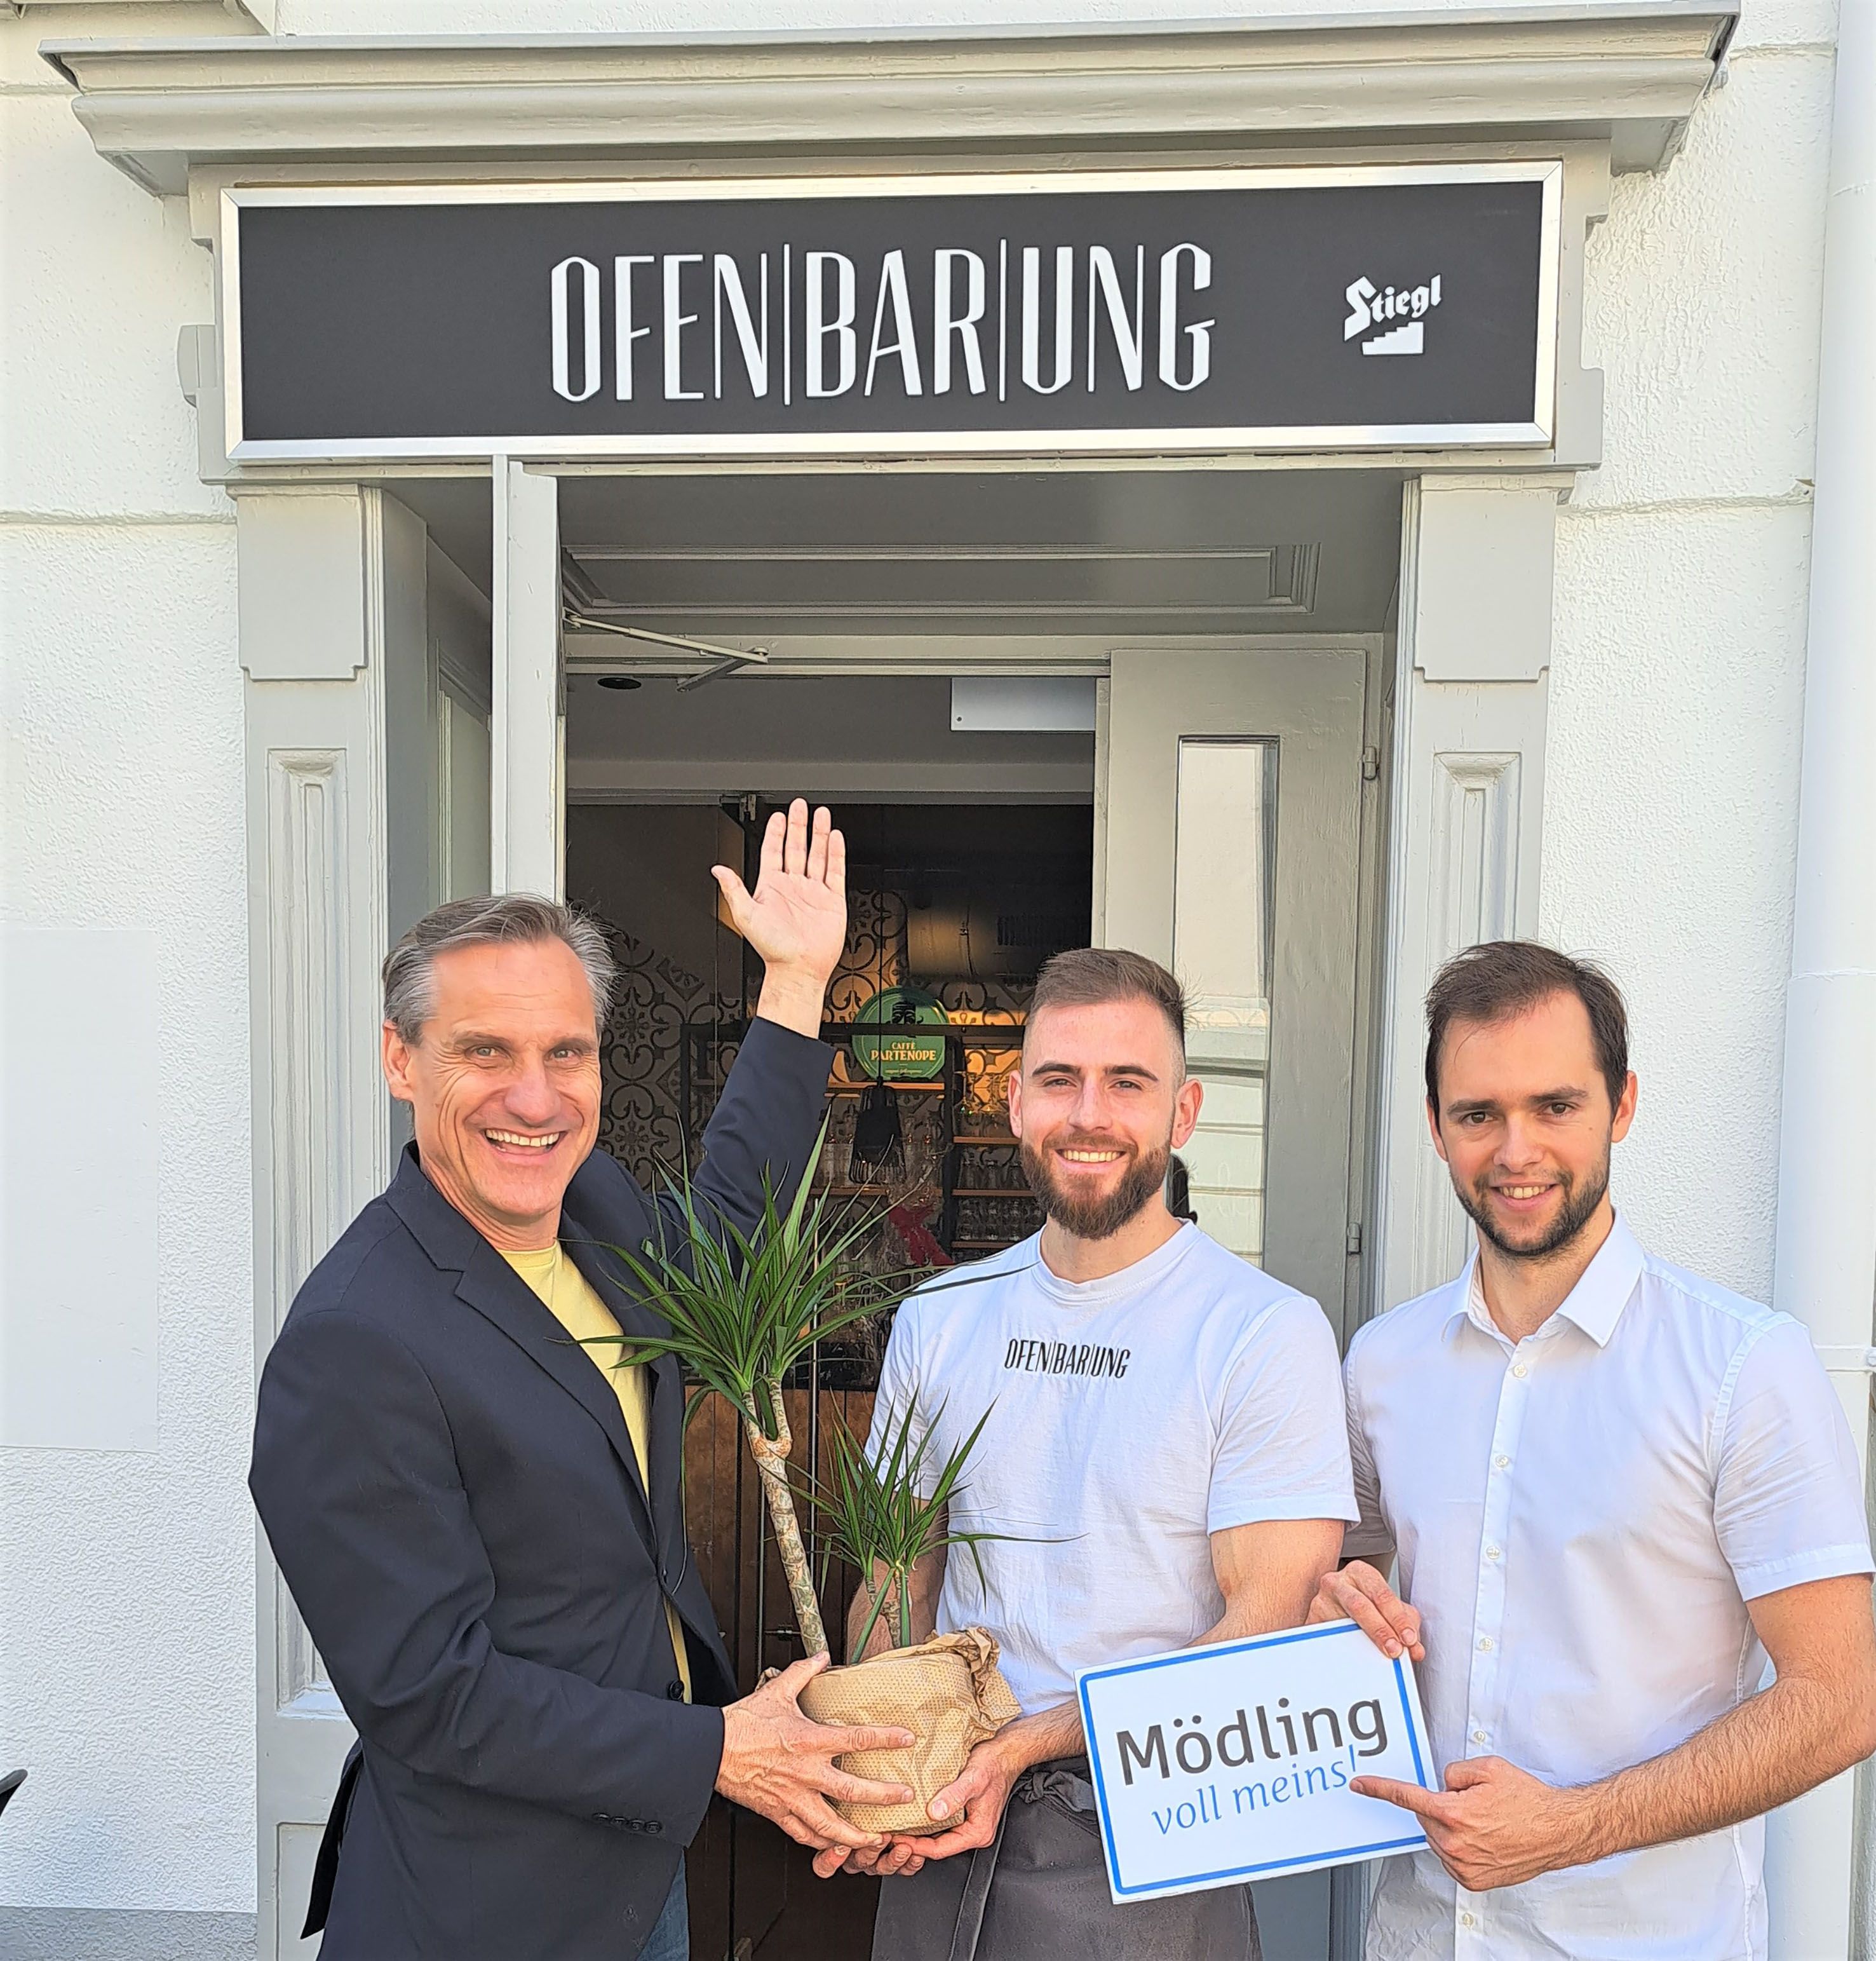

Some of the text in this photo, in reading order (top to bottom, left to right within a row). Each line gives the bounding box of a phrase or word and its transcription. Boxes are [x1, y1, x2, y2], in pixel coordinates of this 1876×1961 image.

[1344, 274, 1442, 342] Stiegl
[870, 1050, 937, 1061] PARTENOPE
[1116, 1697, 1388, 1786] Mödling
[1151, 1785, 1222, 1835] voll
